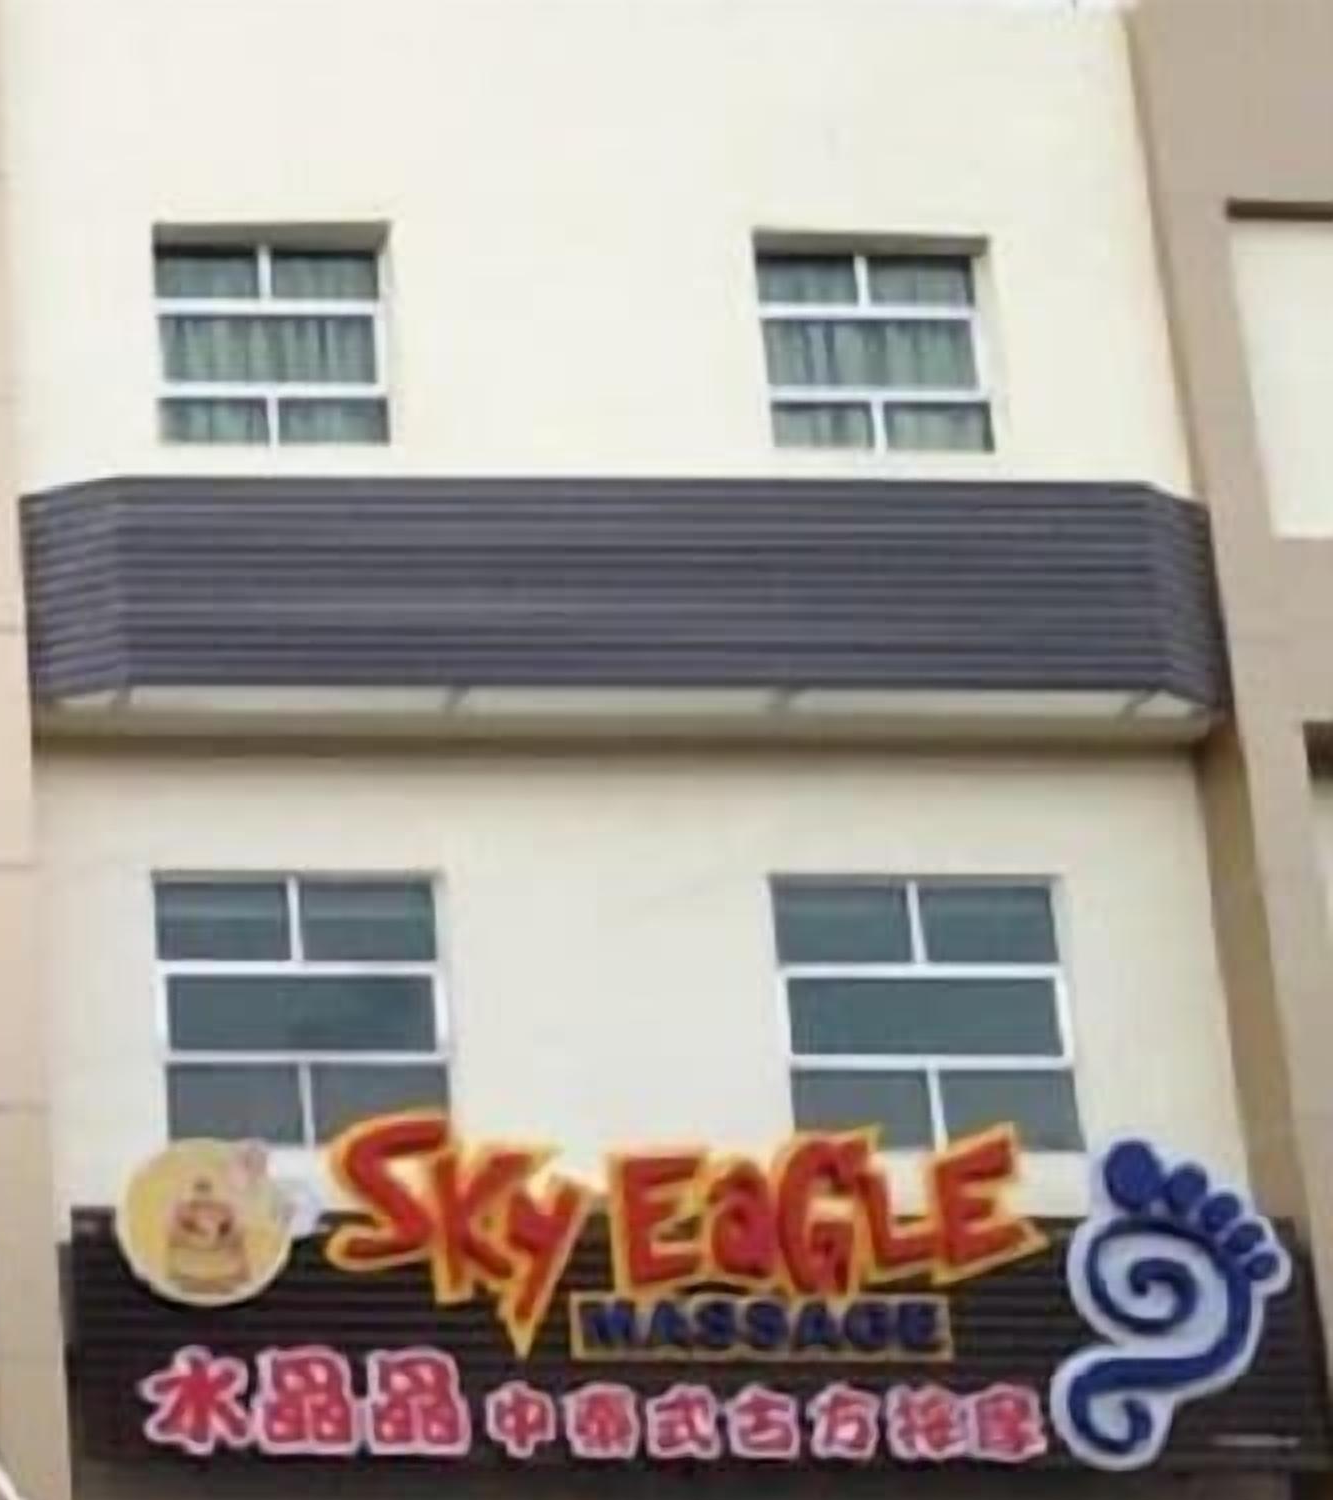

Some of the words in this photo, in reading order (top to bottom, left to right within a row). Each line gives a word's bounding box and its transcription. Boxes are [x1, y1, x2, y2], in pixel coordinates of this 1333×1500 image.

[579, 1298, 940, 1348] MASSAGE
[141, 1346, 471, 1454] 水晶晶
